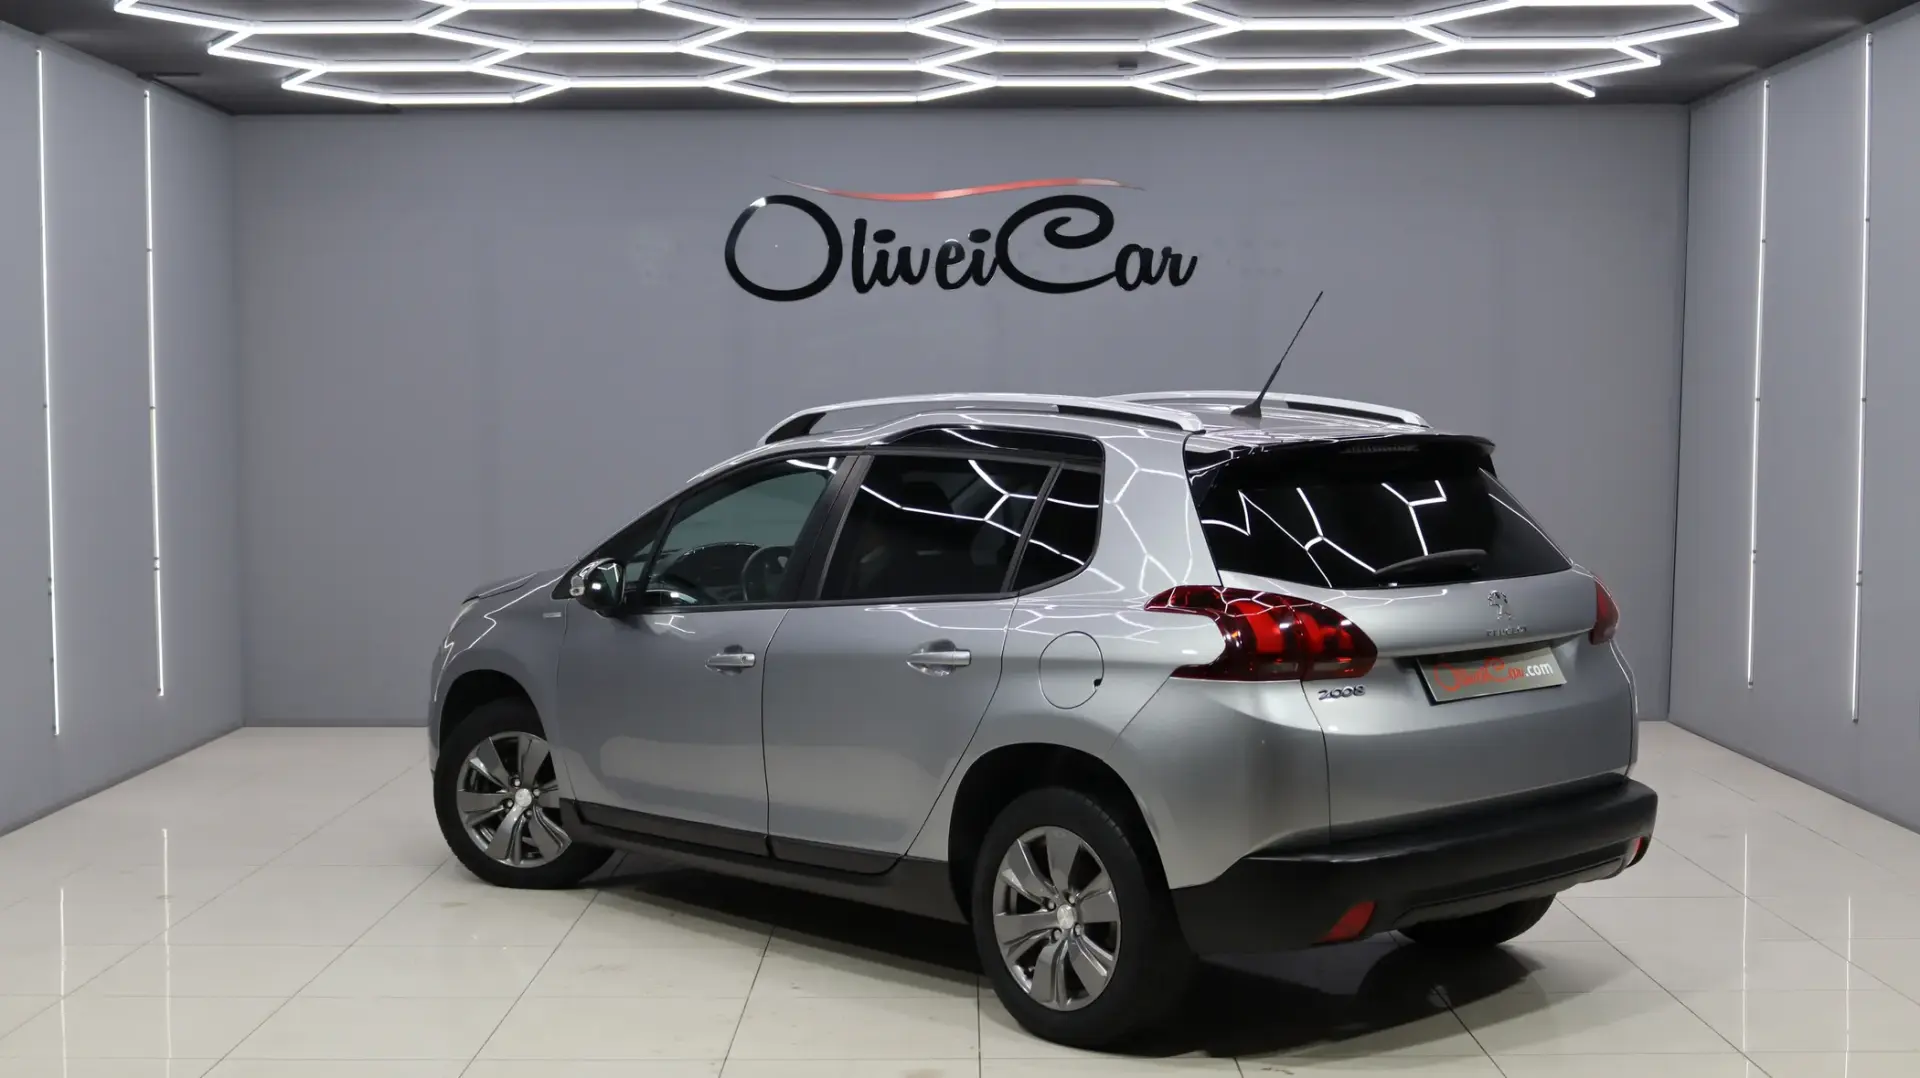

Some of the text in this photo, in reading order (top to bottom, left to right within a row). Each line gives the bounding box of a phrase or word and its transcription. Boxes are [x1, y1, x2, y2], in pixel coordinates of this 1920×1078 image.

[725, 194, 1198, 302] OliveiCar
[1433, 657, 1554, 692] OlCar.com
[1318, 684, 1366, 701] 2008
